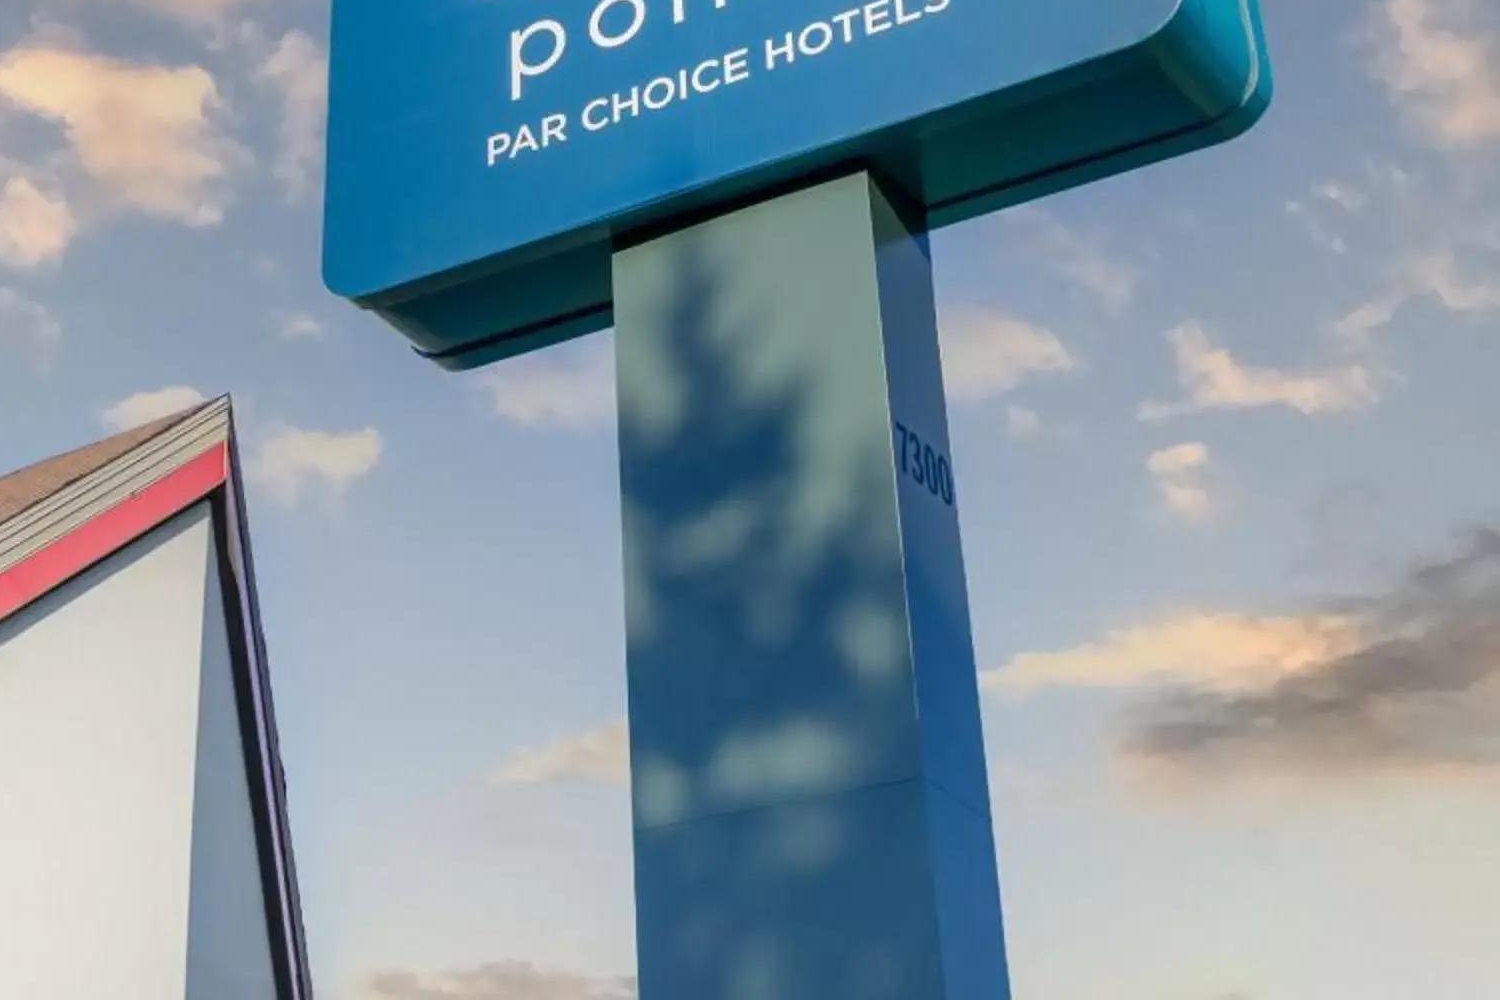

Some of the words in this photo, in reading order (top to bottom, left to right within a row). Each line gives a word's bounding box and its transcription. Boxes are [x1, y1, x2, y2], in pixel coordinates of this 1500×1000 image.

[485, 112, 568, 166] PAR
[580, 47, 750, 133] CHOICE
[895, 420, 954, 507] 7300
